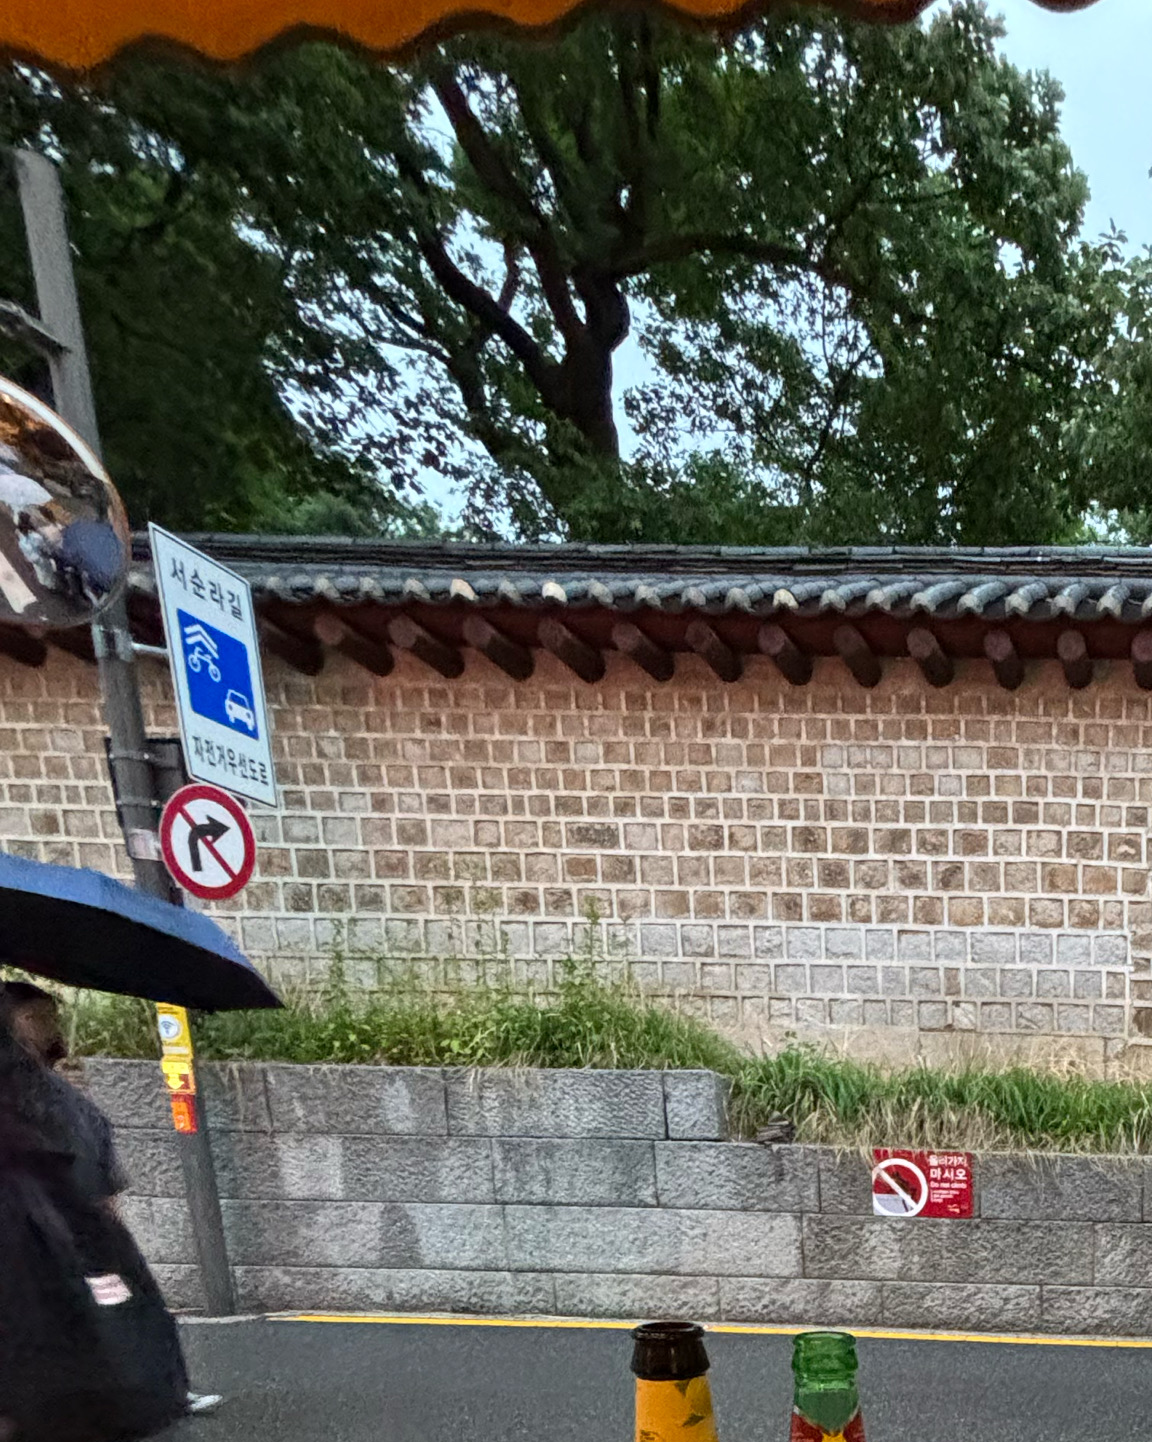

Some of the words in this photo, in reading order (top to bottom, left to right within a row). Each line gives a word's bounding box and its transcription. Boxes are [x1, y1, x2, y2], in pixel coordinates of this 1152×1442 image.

[171, 557, 243, 621] 서순라길
[192, 735, 269, 786] 자전거우선도로
[930, 1168, 968, 1181] 마시오
